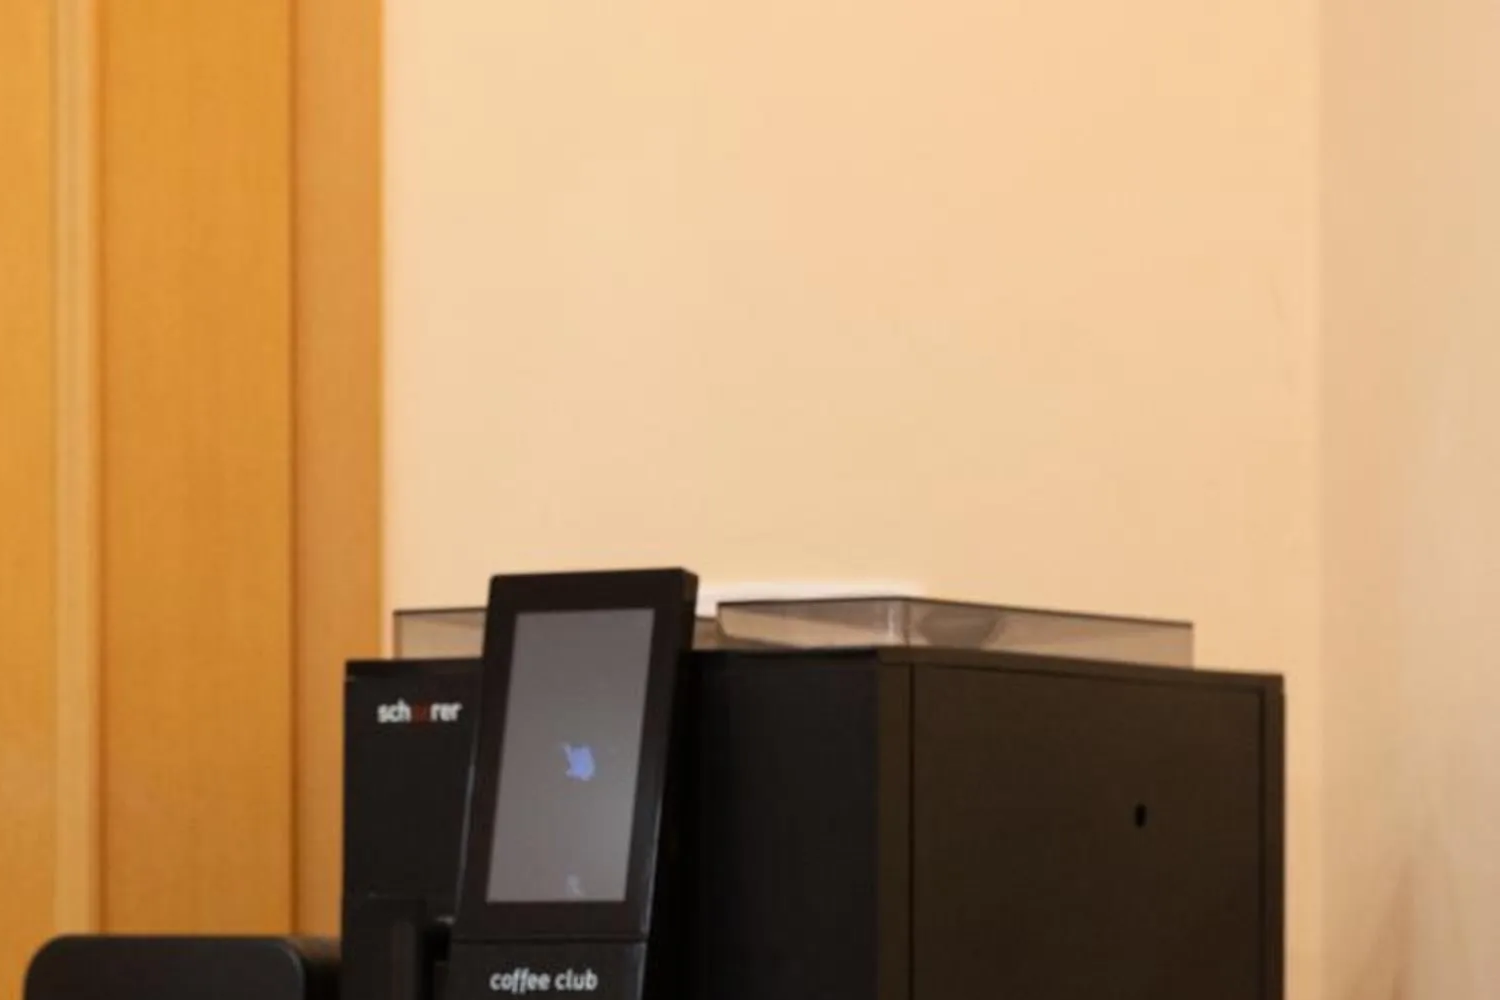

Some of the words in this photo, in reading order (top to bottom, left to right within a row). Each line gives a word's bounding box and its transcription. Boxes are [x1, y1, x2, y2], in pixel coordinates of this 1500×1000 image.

[377, 697, 463, 723] schrer
[489, 967, 550, 994] coffee
[554, 968, 599, 991] club
